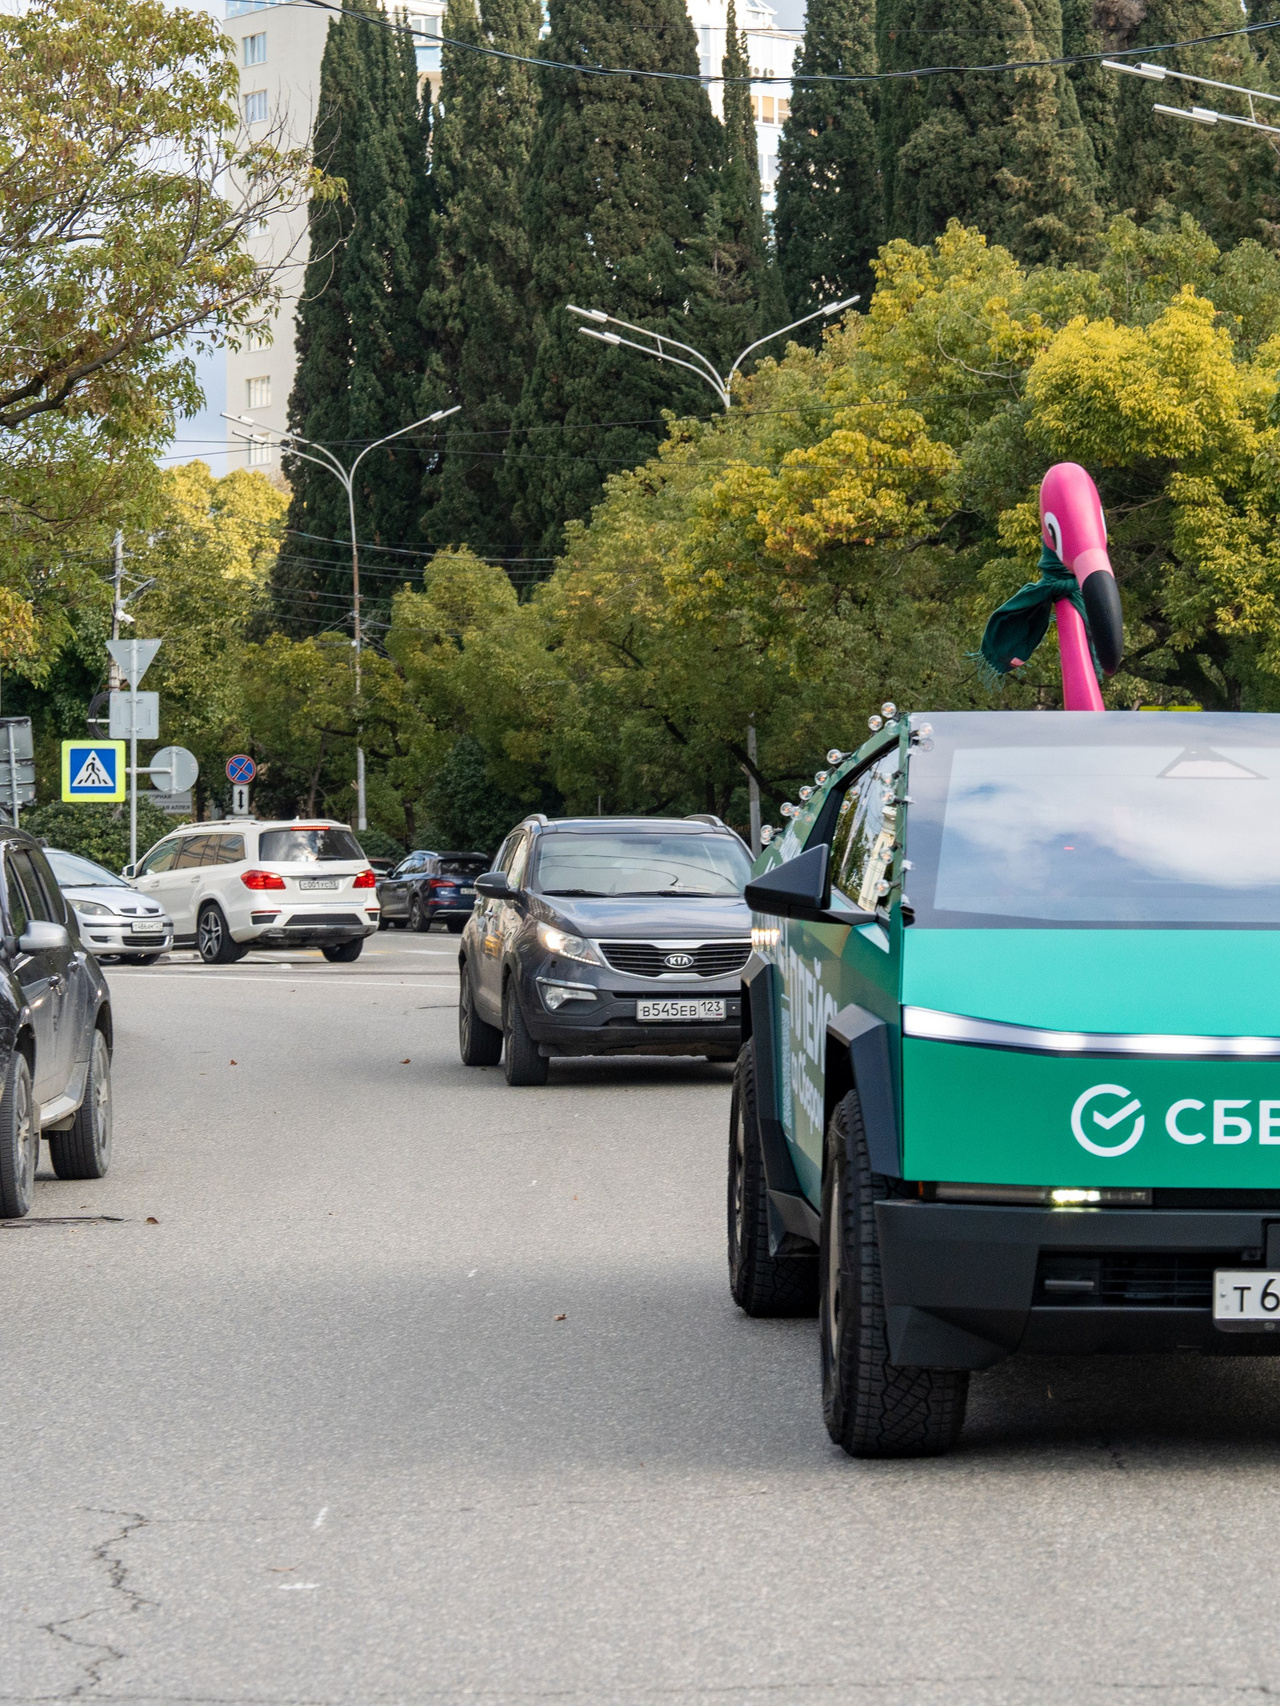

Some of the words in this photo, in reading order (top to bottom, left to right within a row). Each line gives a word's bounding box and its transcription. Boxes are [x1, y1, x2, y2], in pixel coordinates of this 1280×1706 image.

[669, 956, 689, 965] KIA
[643, 1003, 697, 1017] В545ЕВ
[701, 1002, 720, 1012] 123
